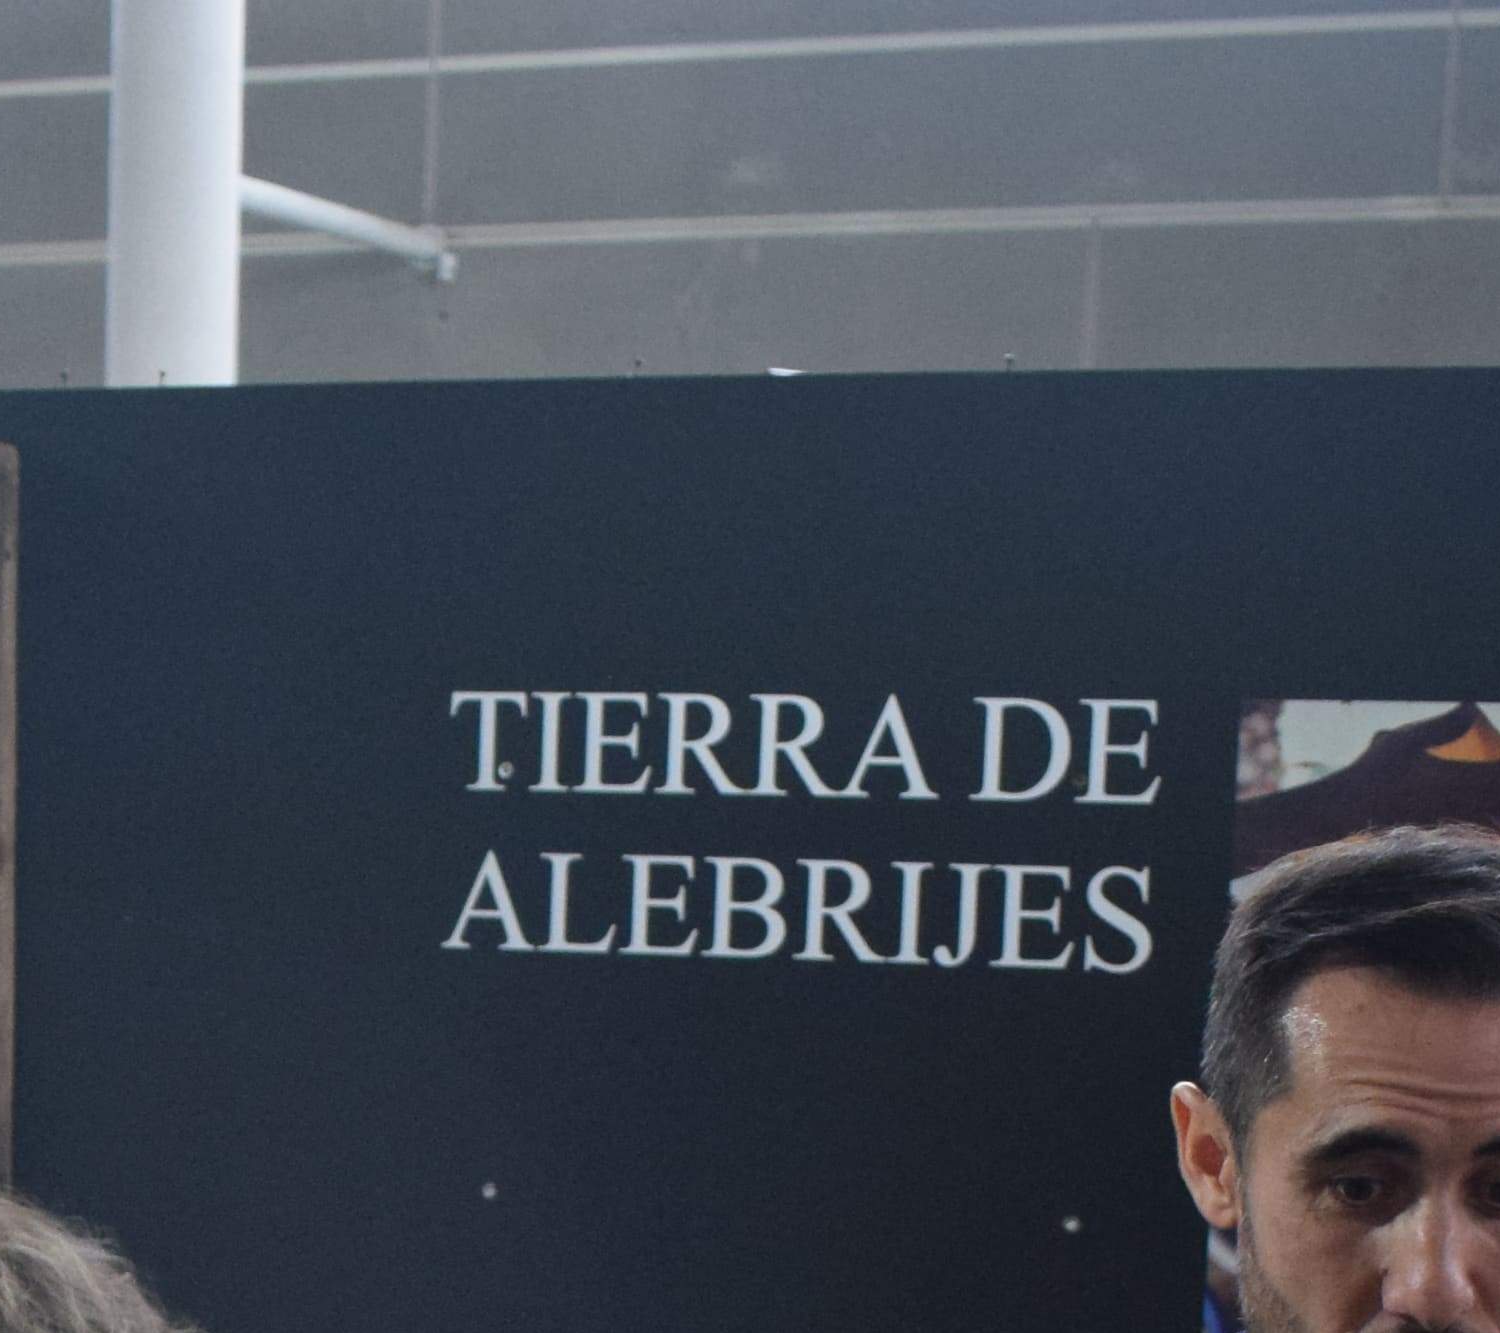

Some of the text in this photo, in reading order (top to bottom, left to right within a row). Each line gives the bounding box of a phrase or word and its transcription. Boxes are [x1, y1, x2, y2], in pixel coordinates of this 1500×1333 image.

[450, 690, 1161, 804] TIERRA DE
[441, 849, 1153, 975] ALEBRIJES
